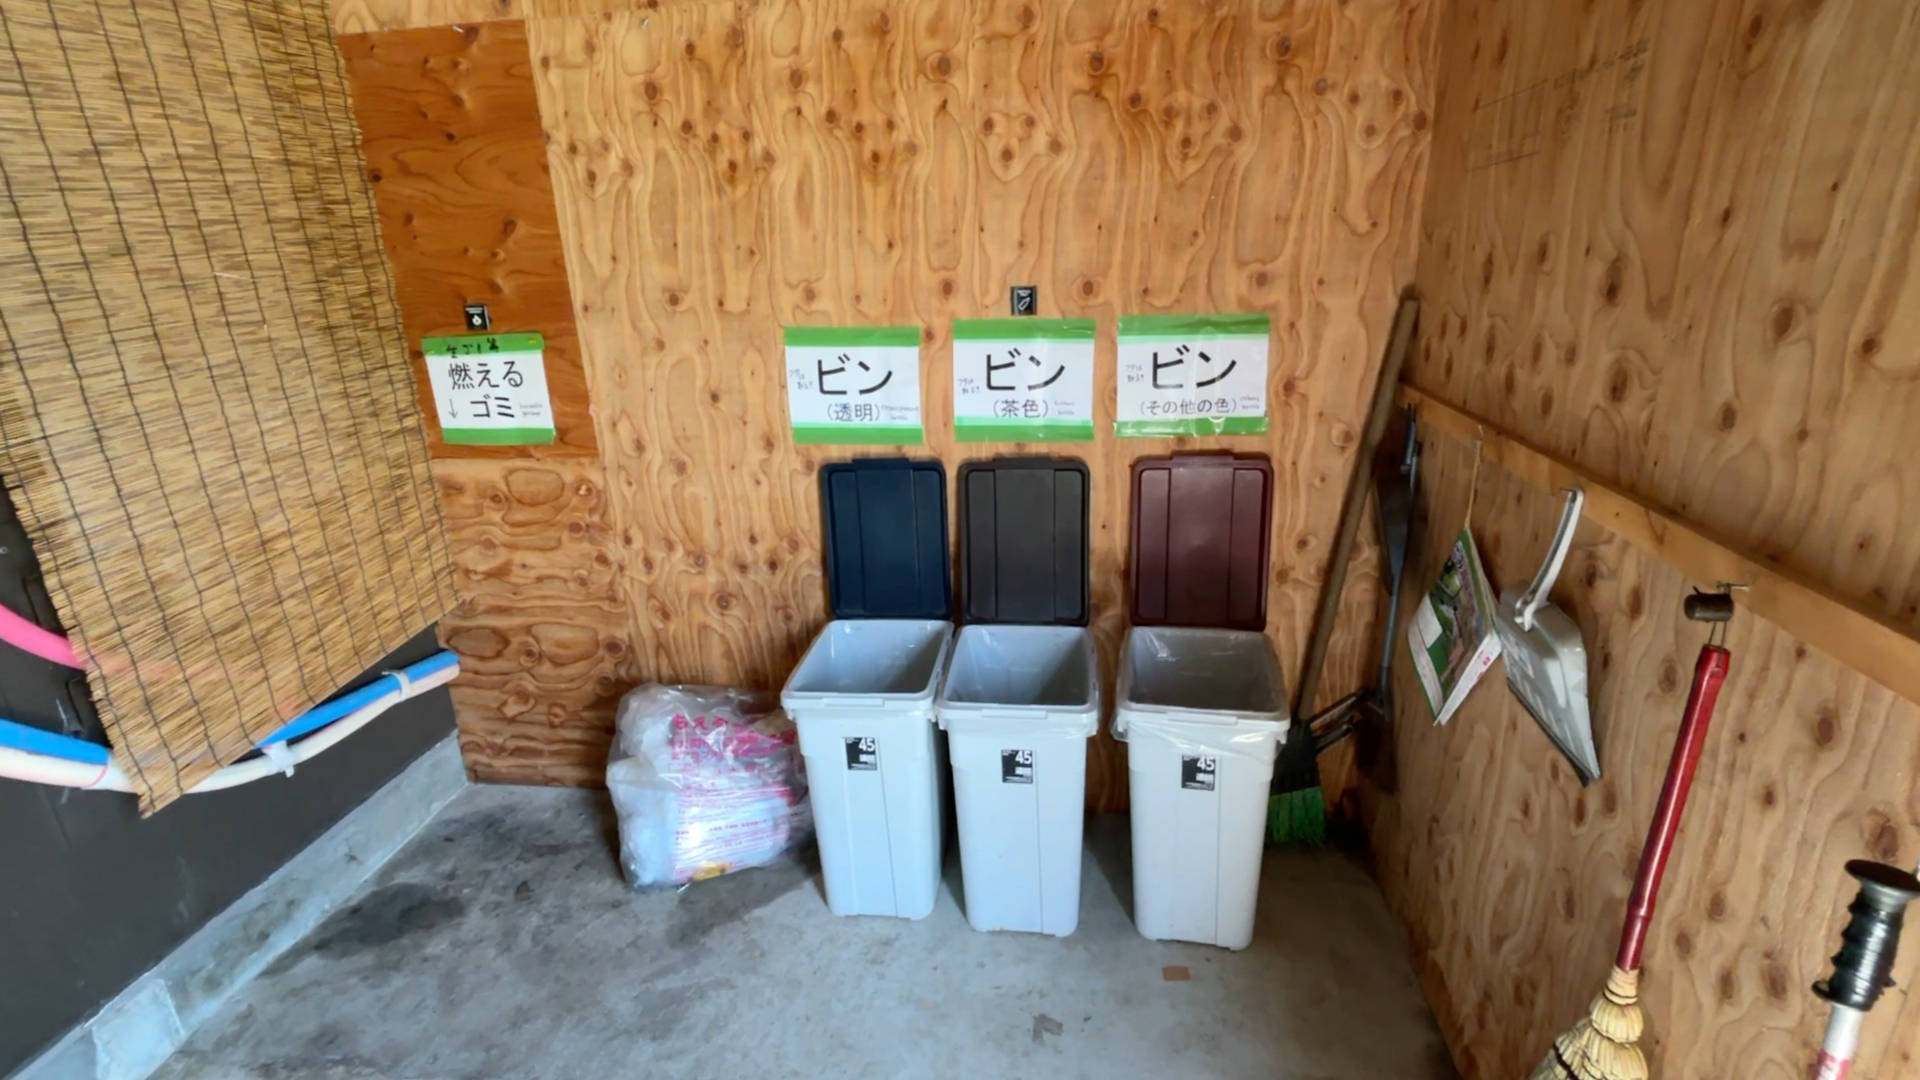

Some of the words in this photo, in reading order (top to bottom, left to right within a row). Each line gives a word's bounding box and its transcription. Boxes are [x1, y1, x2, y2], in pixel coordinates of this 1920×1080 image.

[448, 360, 524, 390] 燃える
[817, 353, 893, 395] ビン
[986, 347, 1065, 391] ビン
[1152, 344, 1237, 389] ビン
[470, 394, 515, 419] ゴミ
[827, 403, 881, 422] （透明）
[993, 399, 1049, 418] （茶色）
[1140, 398, 1237, 416] （その他の色）
[858, 737, 875, 752] 45
[1015, 750, 1032, 764] 45
[1197, 756, 1215, 771] 45
